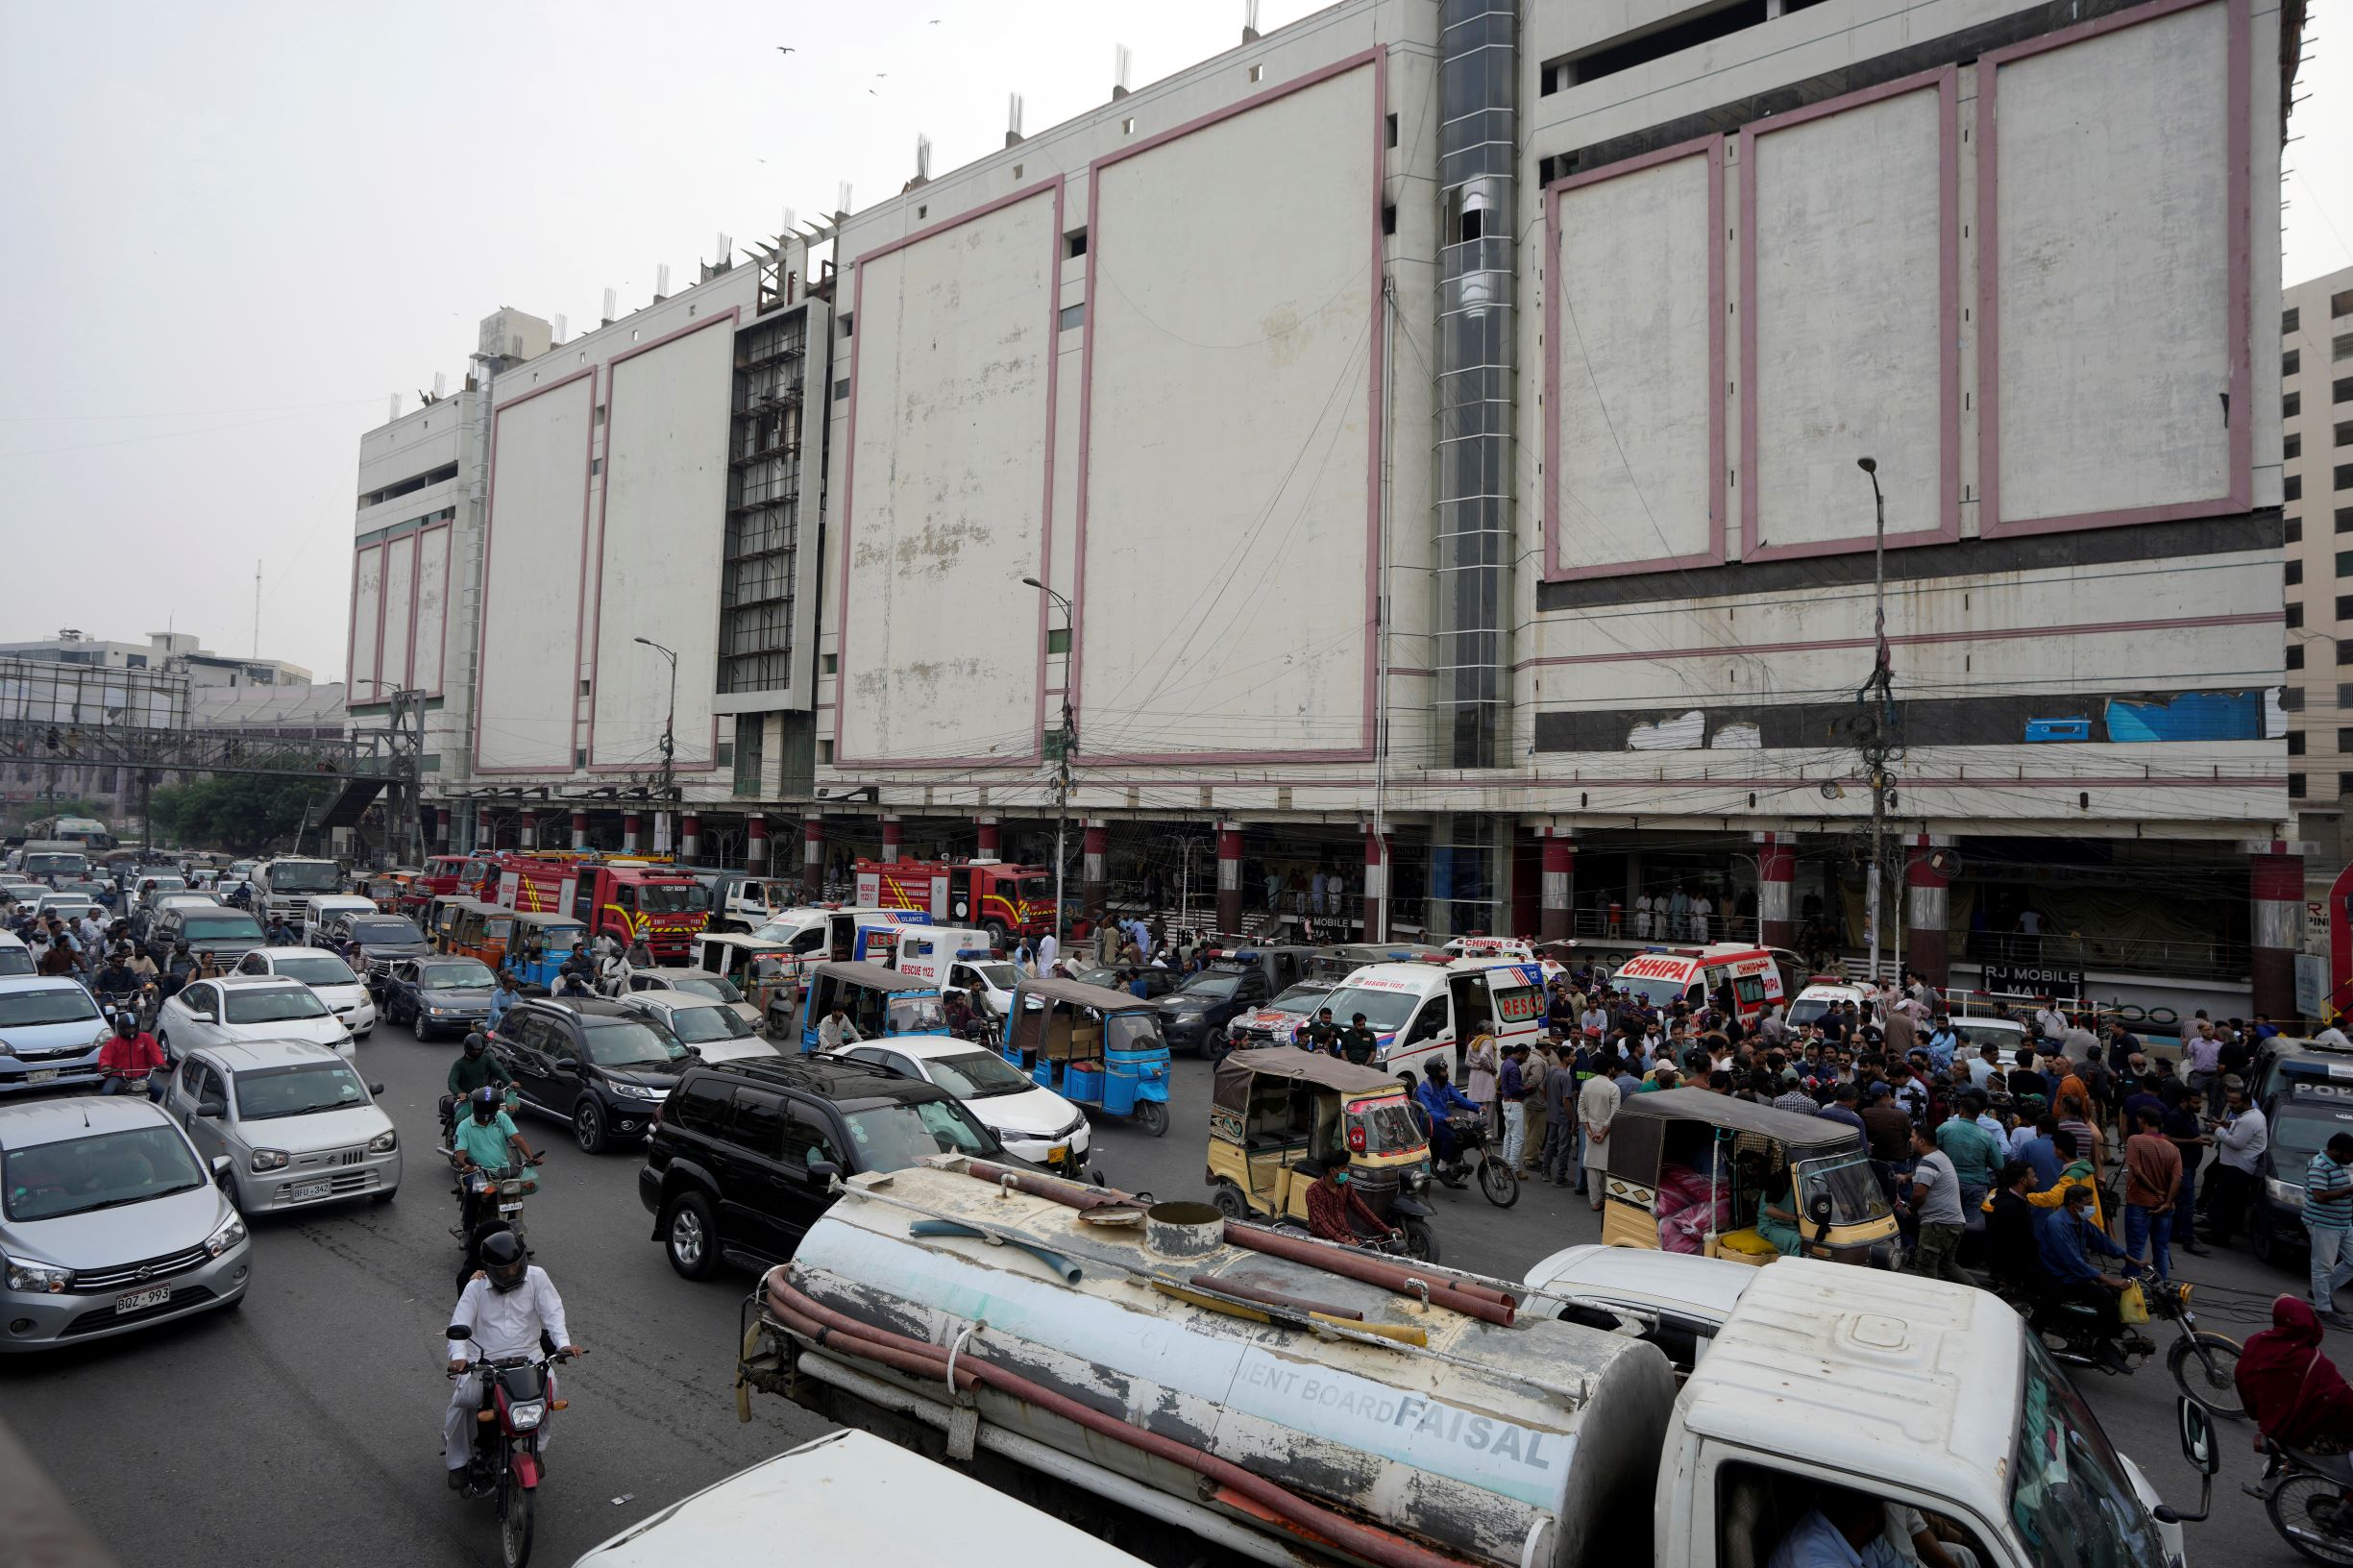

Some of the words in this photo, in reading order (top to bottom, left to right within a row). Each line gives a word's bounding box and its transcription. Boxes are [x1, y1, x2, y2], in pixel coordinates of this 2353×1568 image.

[1313, 918, 1349, 928] MOBILE
[1465, 939, 1503, 949] CHHIPA
[900, 964, 921, 977] RESCUE
[922, 968, 935, 978] 1122
[1623, 958, 1691, 981] CHHIPA
[1985, 966, 2008, 978] RJ
[2014, 968, 2080, 984] MOBILE
[1363, 980, 1389, 989] RESCUE
[314, 1184, 329, 1194] 342
[117, 1295, 139, 1311] BQZ
[148, 1287, 169, 1303] 993
[1300, 1377, 1396, 1426] BOARD
[1393, 1394, 1551, 1470] FAISAL
